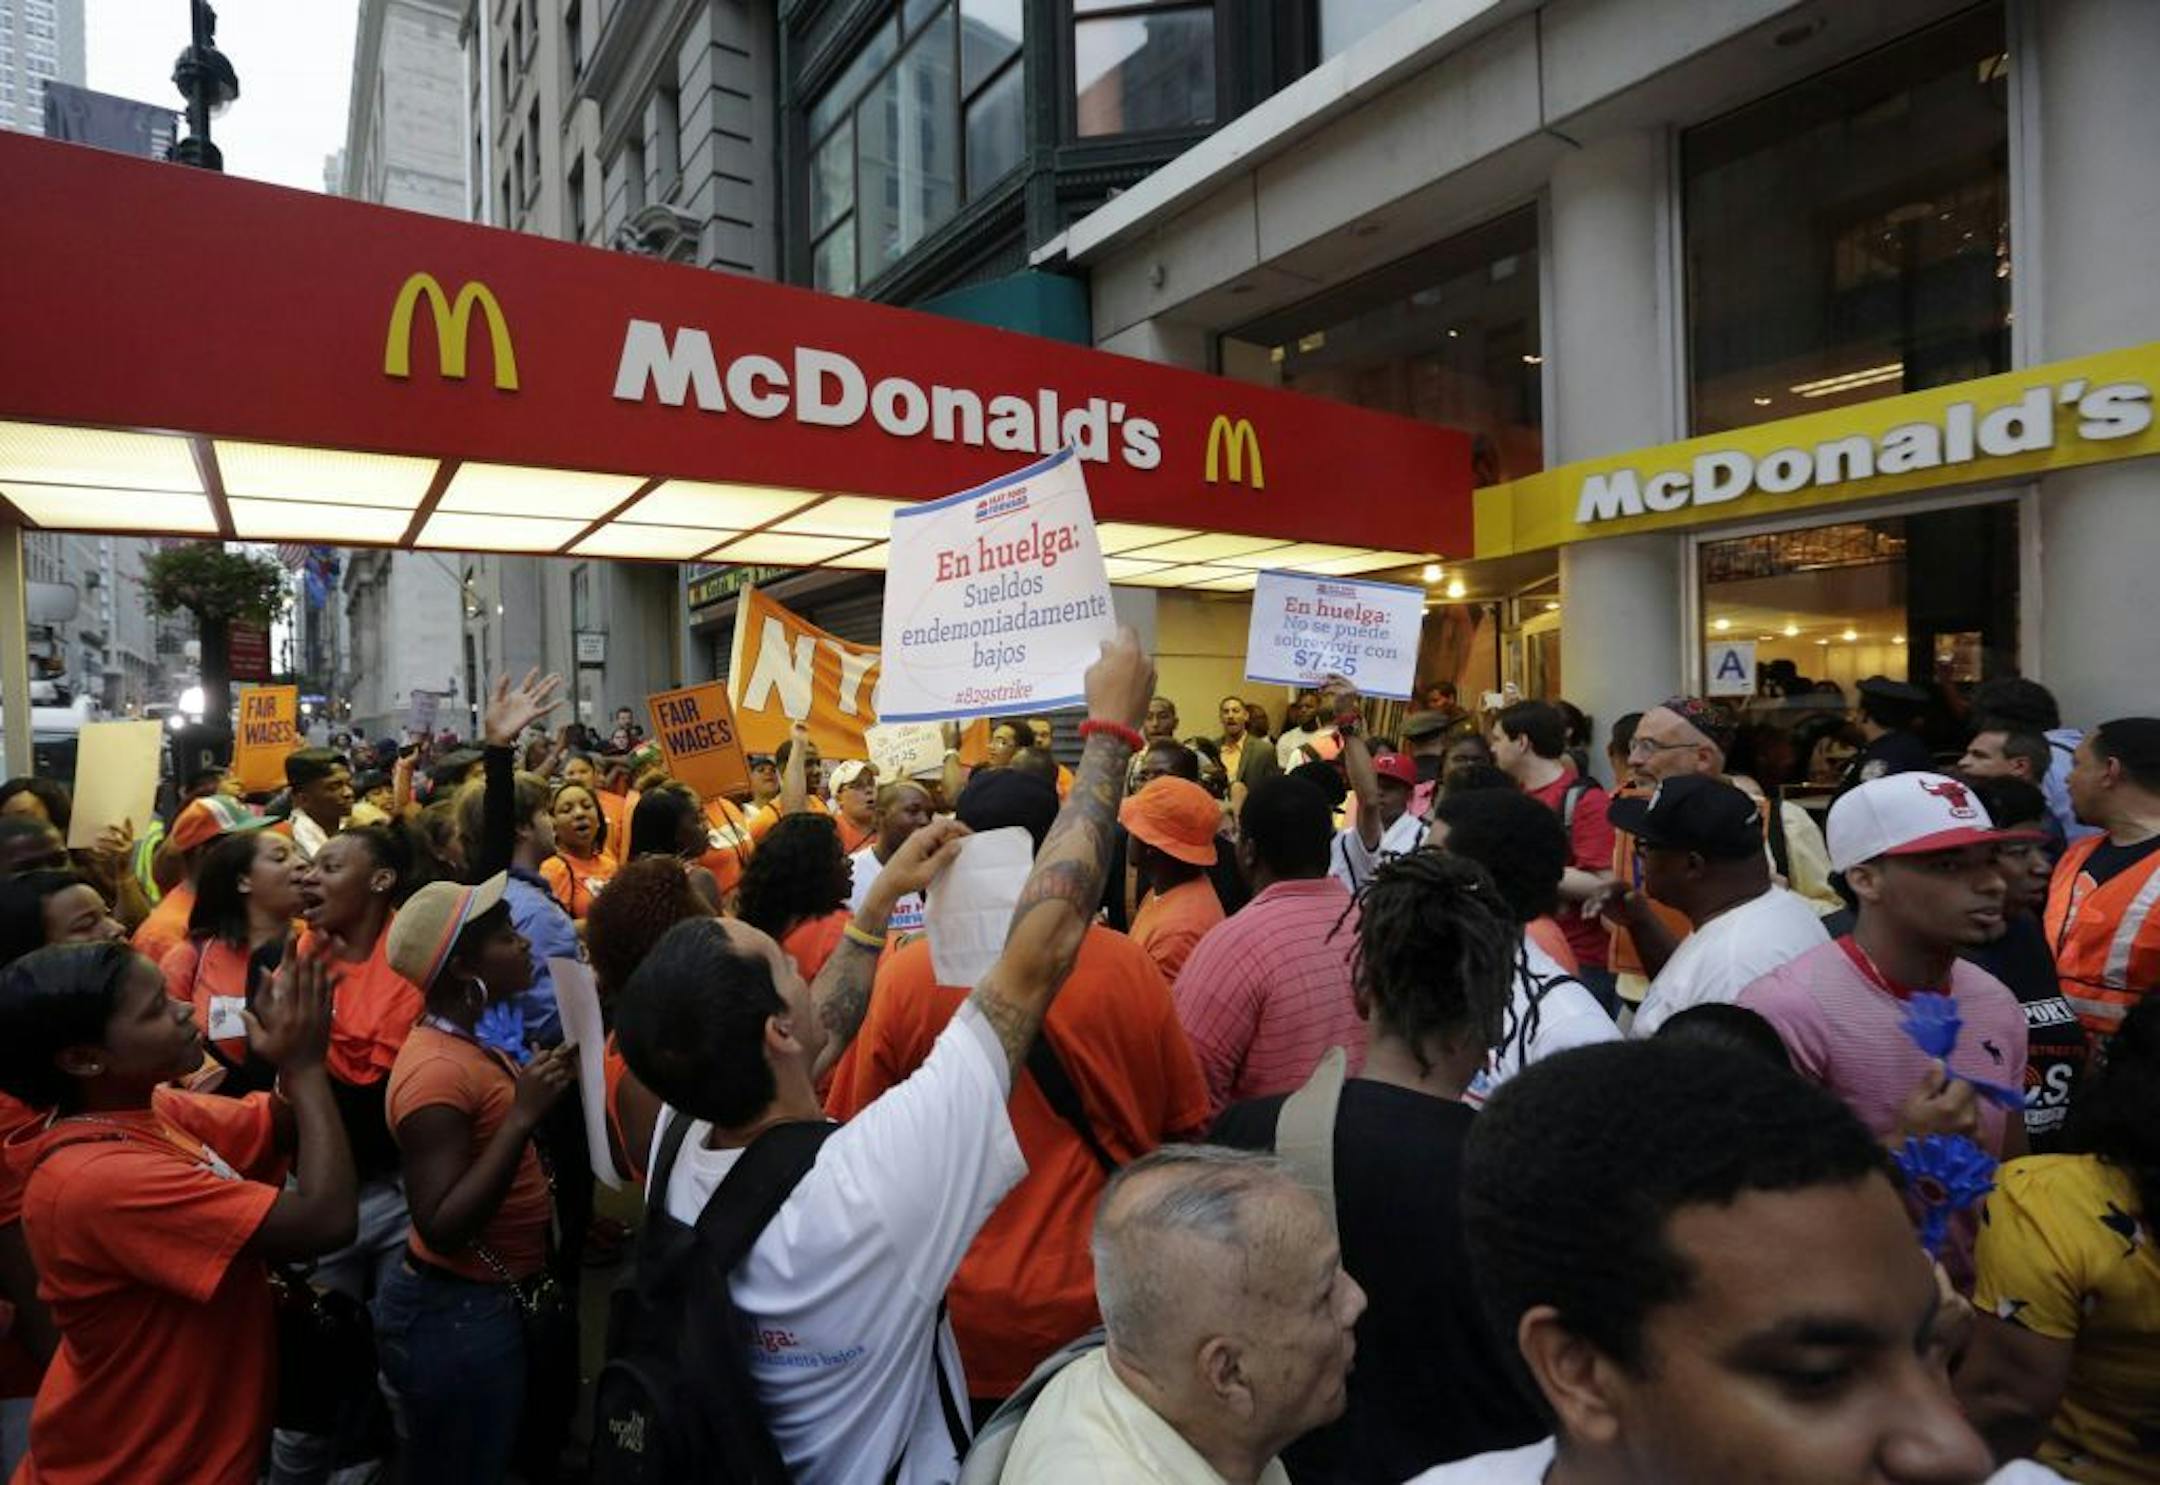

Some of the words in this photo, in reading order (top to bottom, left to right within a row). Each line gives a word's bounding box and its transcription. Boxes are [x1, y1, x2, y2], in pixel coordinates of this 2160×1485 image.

[613, 318, 1162, 471] McDonald's
[1575, 379, 2153, 524] McDonald's
[936, 550, 971, 583] En
[978, 521, 1080, 574] huelga:
[964, 571, 1044, 608] Sueldos
[902, 595, 1107, 647] endemoniadamente
[1284, 596, 1311, 615] En
[1316, 598, 1391, 627] huelga:
[1283, 614, 1308, 632] No
[1312, 620, 1330, 633] se
[1335, 621, 1390, 641] puede
[973, 642, 1026, 673] bajos
[1274, 633, 1363, 656] sobrevivir
[1365, 644, 1398, 660] con
[1294, 649, 1358, 677] $7.25
[1716, 649, 1746, 680] A
[247, 695, 276, 719] FAIR
[657, 696, 701, 728] FAIR
[245, 719, 292, 745] WAGES
[665, 719, 732, 756] WAGES
[2024, 1000, 2074, 1024] PORT
